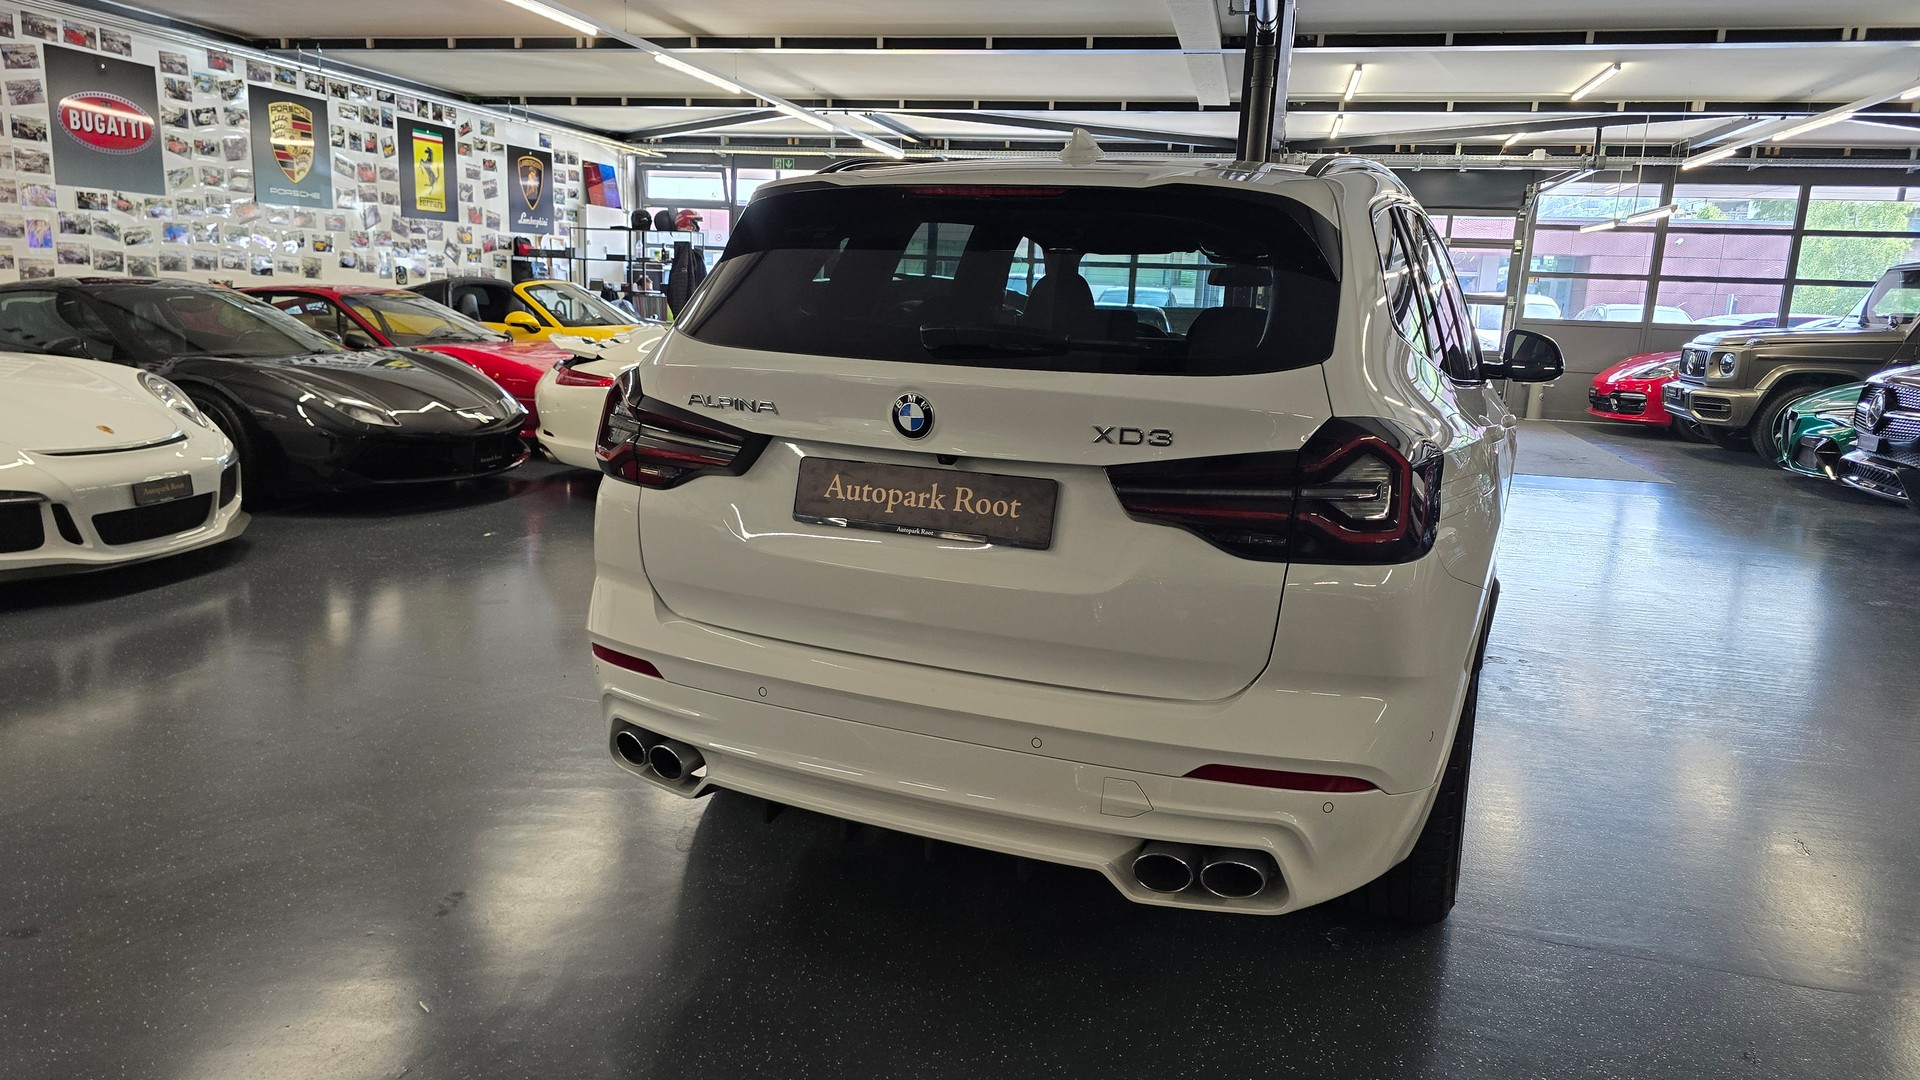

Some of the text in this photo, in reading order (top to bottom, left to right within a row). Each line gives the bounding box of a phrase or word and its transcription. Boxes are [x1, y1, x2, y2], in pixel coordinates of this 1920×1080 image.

[271, 104, 310, 119] PORSCHE
[69, 109, 145, 140] BUGATTI
[270, 187, 320, 200] PORSCHE
[420, 197, 443, 209] Ferrari
[688, 394, 780, 416] ALPINA
[895, 394, 930, 410] BMW
[1092, 426, 1173, 447] XD3
[824, 474, 1022, 518] Autopark Root
